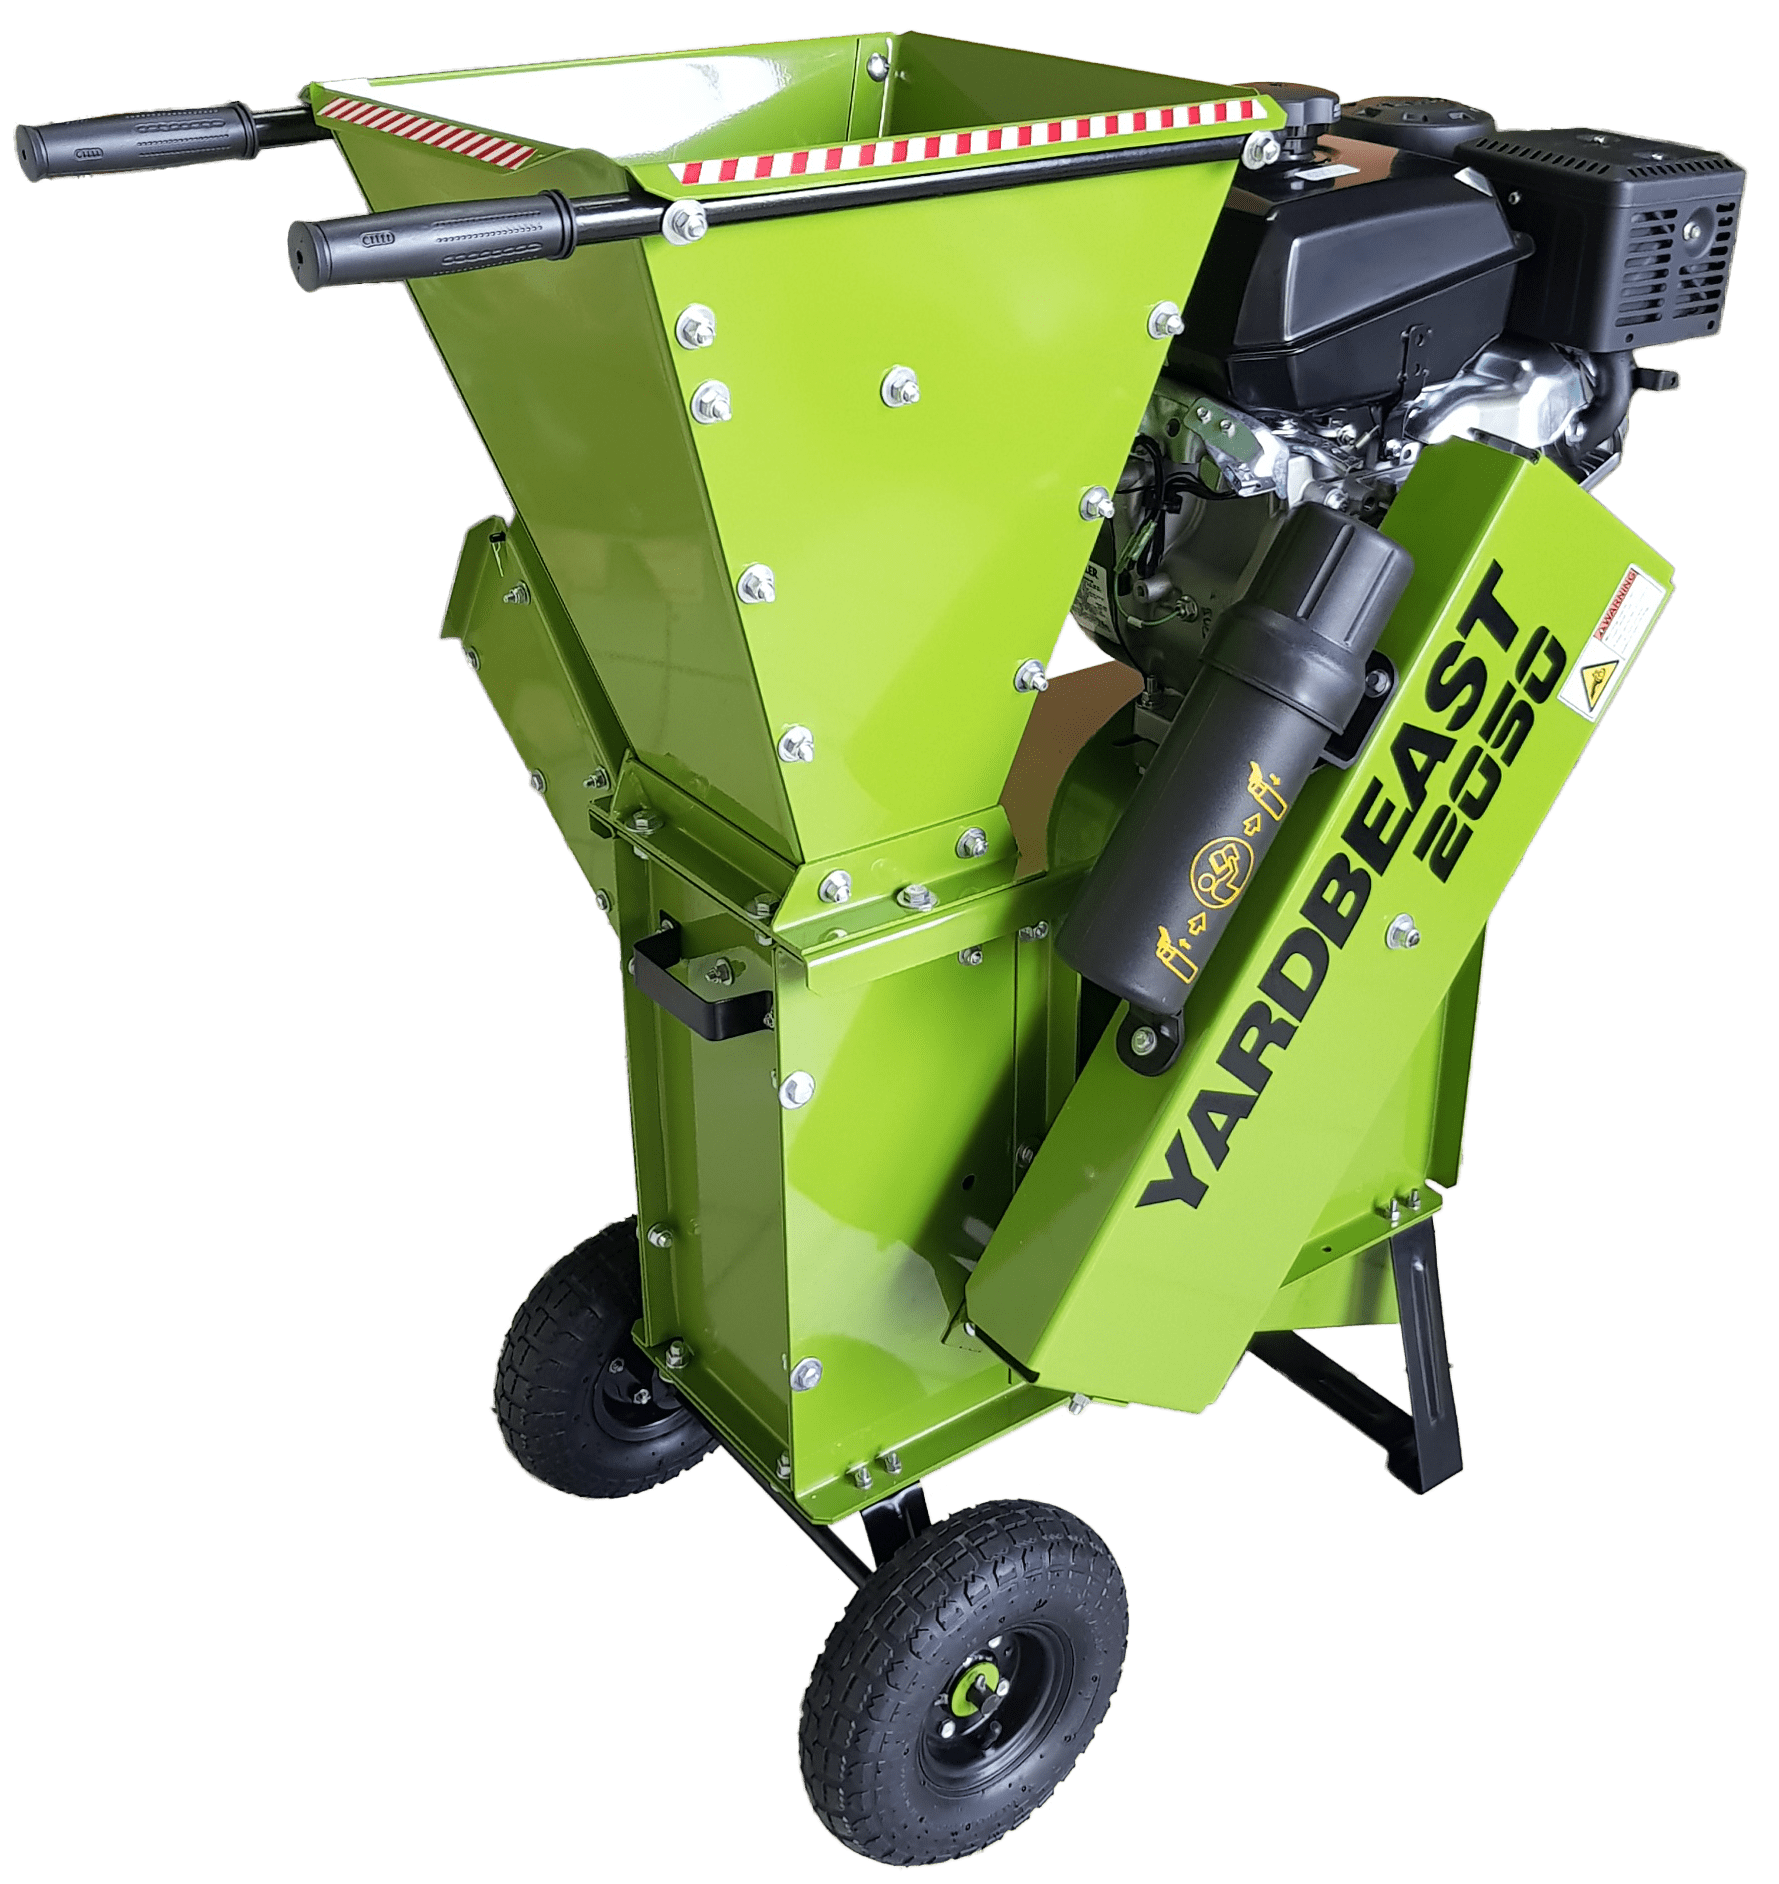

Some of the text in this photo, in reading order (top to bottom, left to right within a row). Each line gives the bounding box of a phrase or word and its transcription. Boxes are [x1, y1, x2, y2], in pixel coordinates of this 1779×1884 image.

[1602, 570, 1637, 626] WARNING
[1414, 625, 1567, 883] 2050
[1136, 559, 1518, 1209] YARDBEAST
